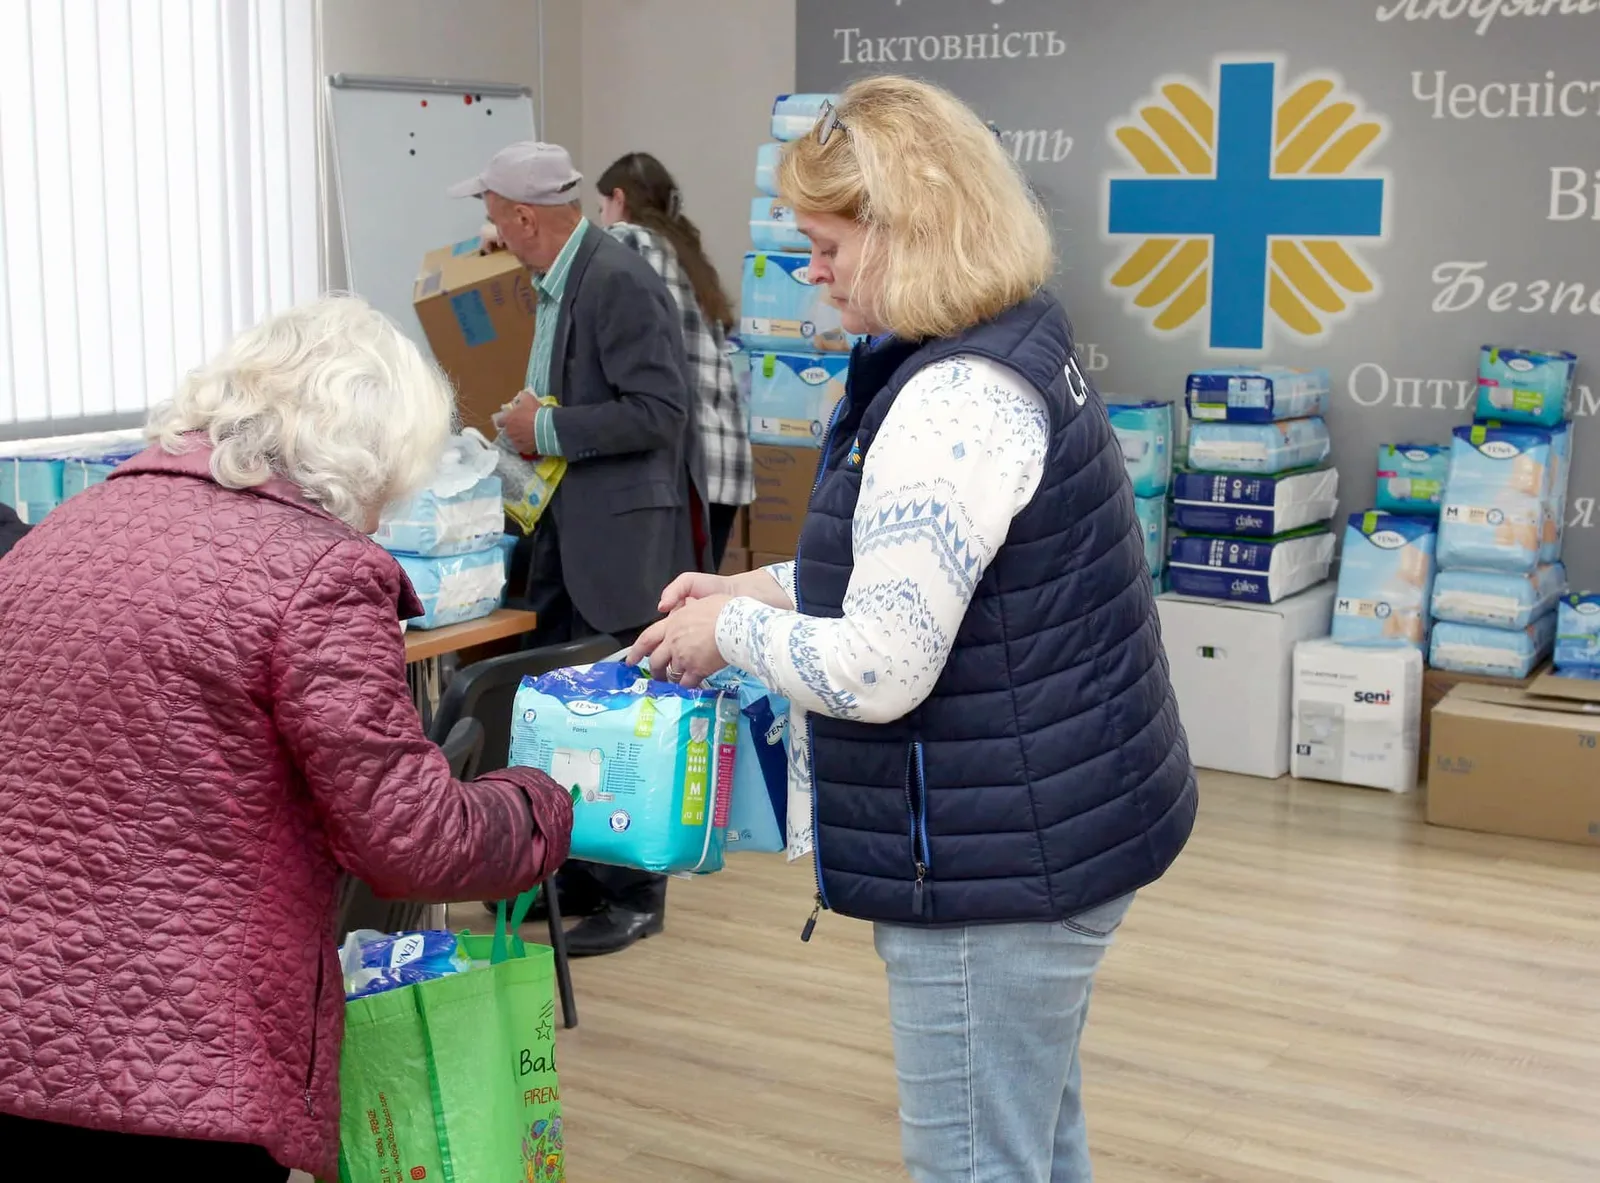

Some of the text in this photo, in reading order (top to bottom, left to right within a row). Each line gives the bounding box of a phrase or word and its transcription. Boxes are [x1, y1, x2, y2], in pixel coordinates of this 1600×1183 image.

[834, 23, 1066, 63] Тактовність
[1353, 688, 1391, 704] seni
[766, 717, 790, 740] TENA
[690, 782, 701, 797] M
[396, 938, 419, 965] TENA
[524, 1085, 560, 1108] FIREN
